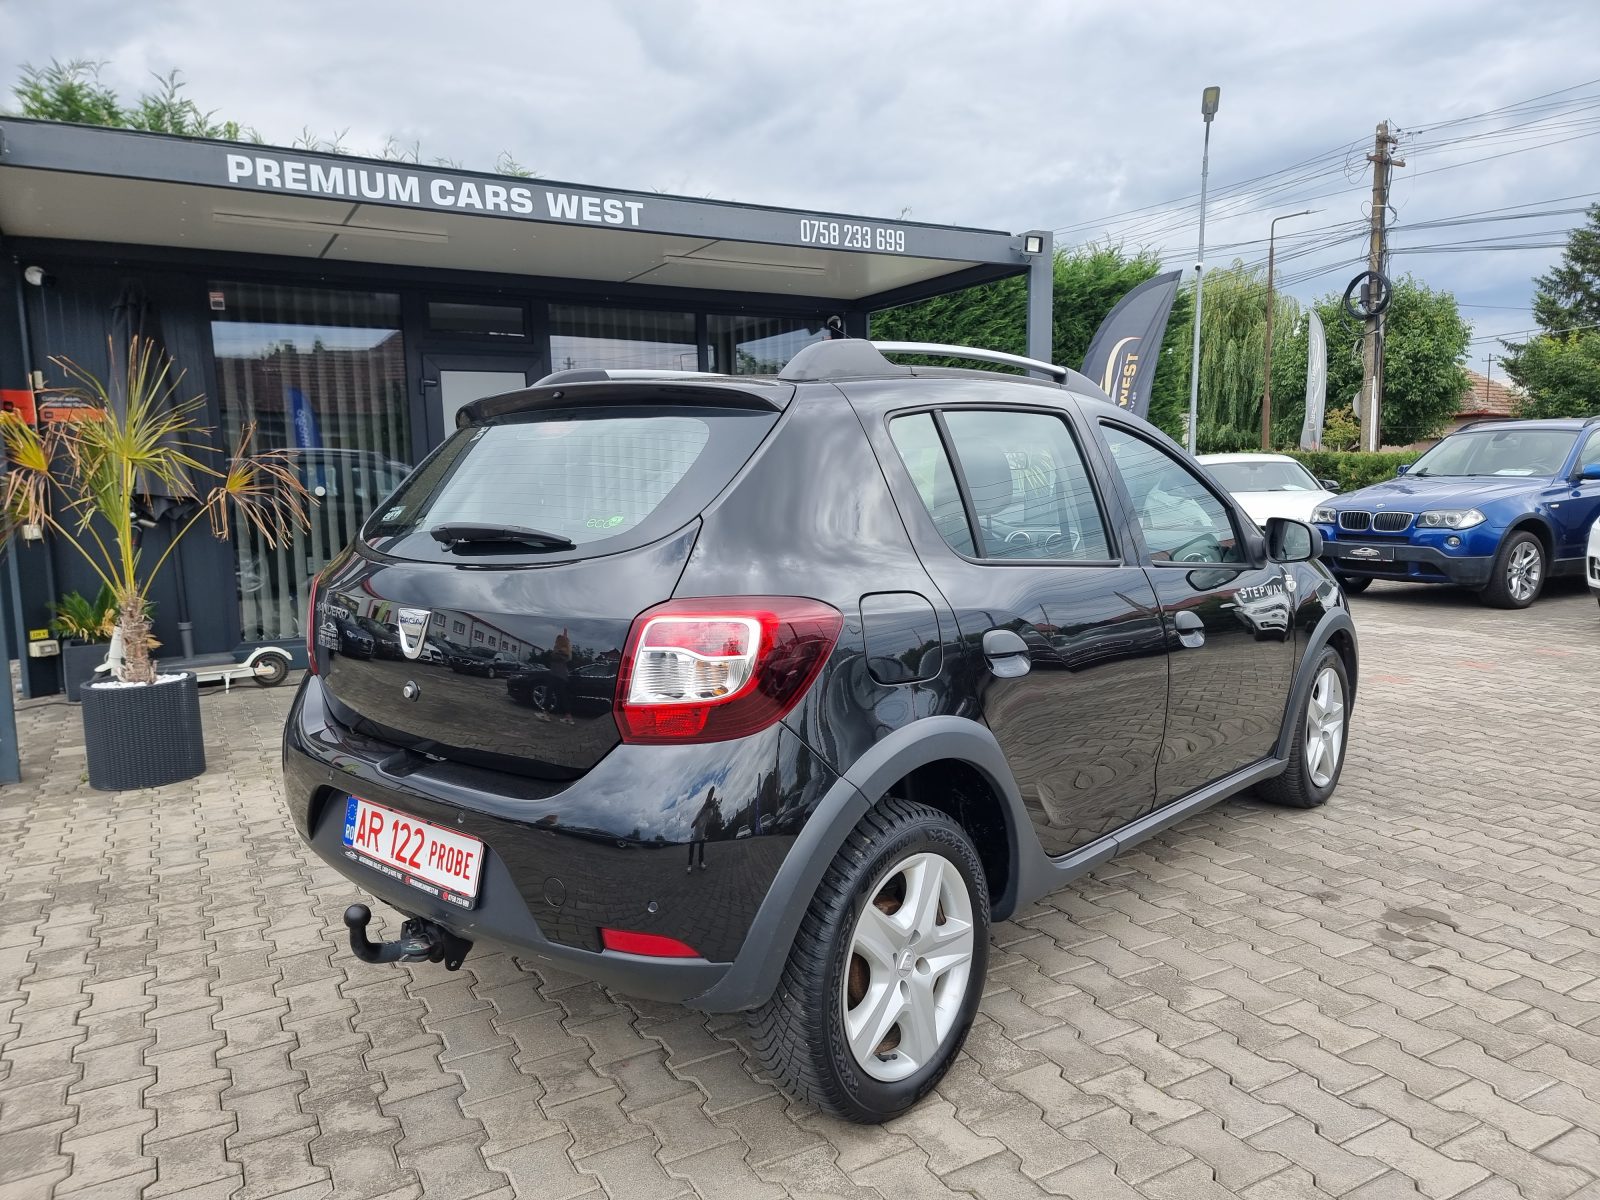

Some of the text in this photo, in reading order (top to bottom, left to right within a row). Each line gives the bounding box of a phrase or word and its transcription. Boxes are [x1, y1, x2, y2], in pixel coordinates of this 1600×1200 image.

[226, 153, 644, 226] PREMIUM CARS WEST
[800, 219, 905, 252] 0758 233 699
[1119, 352, 1139, 407] WEST
[1240, 584, 1284, 599] STEPWAY
[316, 601, 349, 620] SANDERO
[399, 615, 424, 625] DACIA
[344, 824, 355, 841] RO
[355, 807, 385, 853] AR
[390, 818, 426, 870] 122
[428, 840, 474, 881] PROBE
